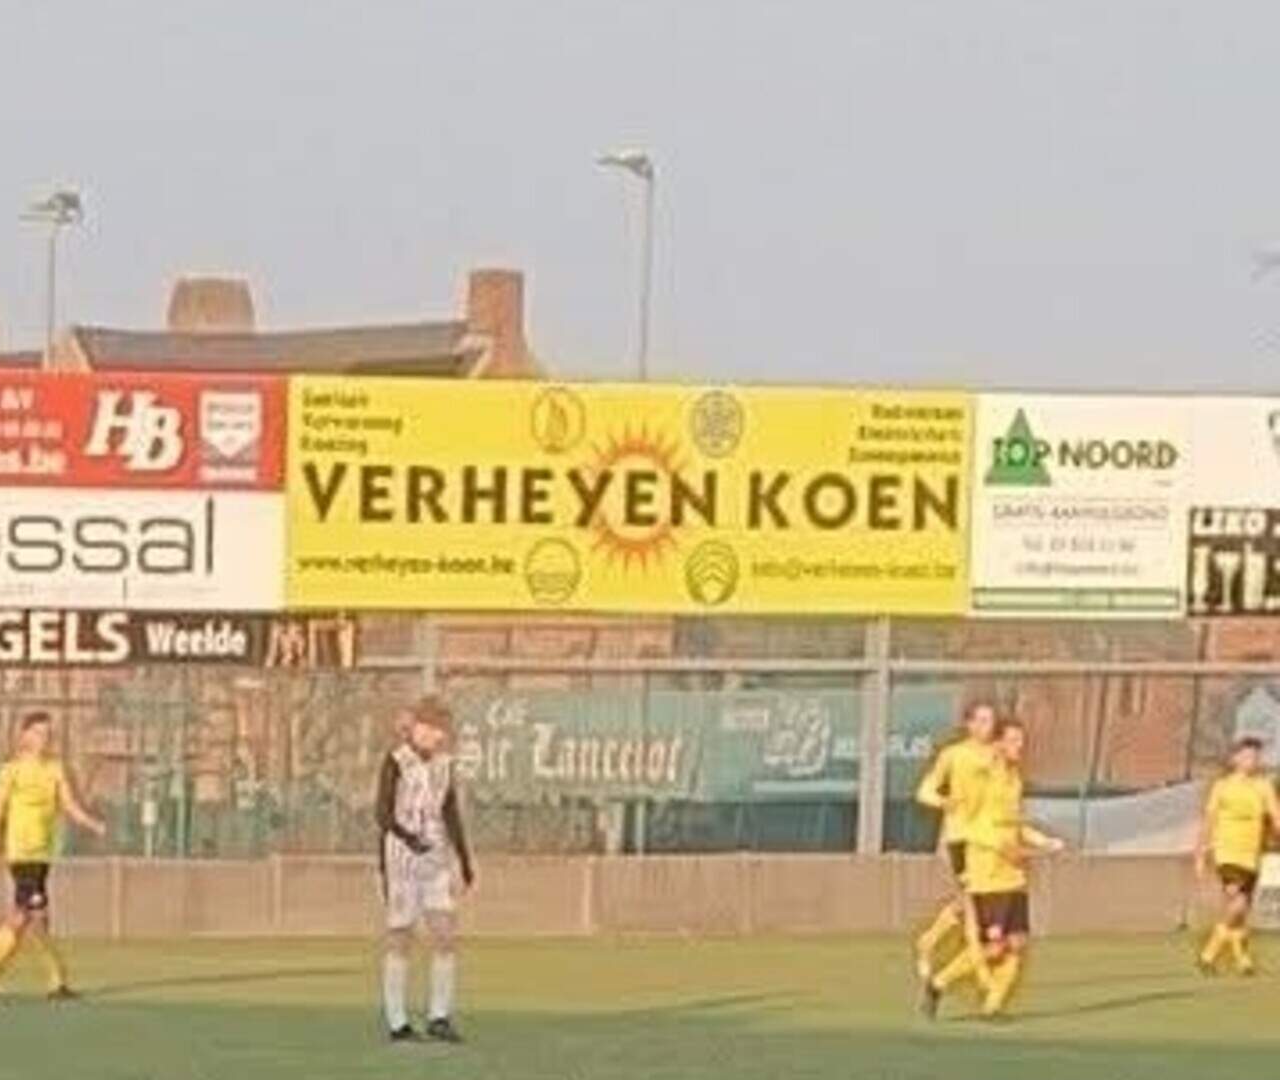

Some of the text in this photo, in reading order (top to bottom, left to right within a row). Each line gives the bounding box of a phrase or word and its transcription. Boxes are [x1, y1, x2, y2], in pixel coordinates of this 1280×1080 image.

[85, 387, 185, 472] HB
[992, 436, 1178, 471] TOP NOORD
[302, 460, 961, 533] VERHEYEN KOEN
[146, 620, 247, 657] Weelde
